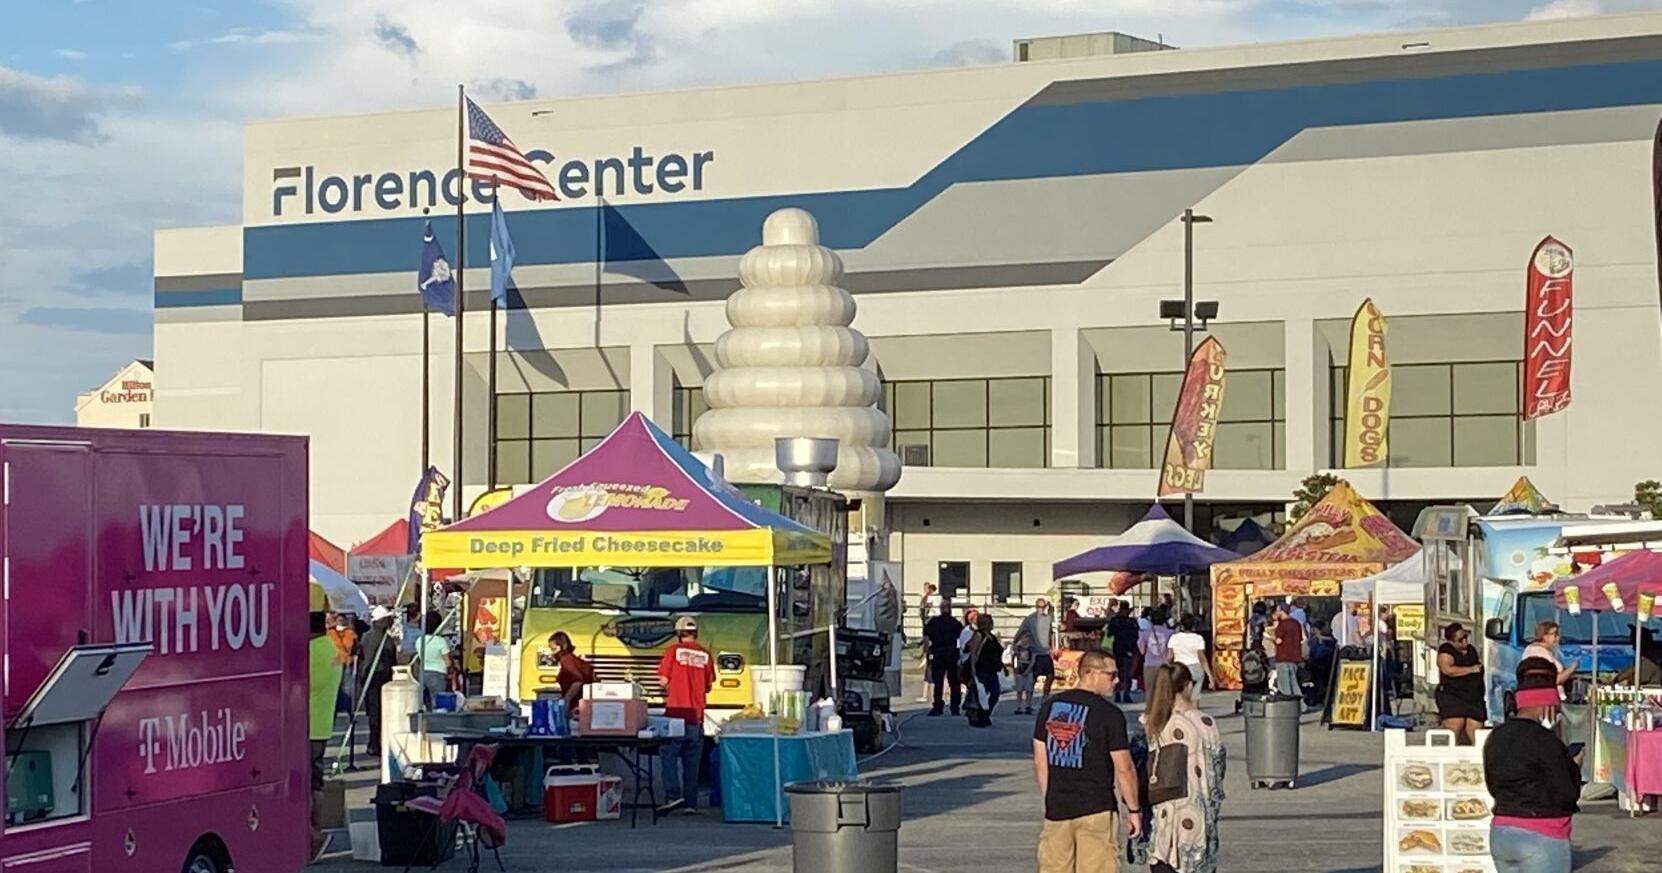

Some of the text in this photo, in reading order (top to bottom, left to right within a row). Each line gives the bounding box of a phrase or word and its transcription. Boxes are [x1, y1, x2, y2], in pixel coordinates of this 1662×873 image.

[1531, 278, 1571, 398] FUNNEL
[101, 390, 147, 404] Garden
[1359, 396, 1384, 463] DOGS
[583, 491, 690, 512] LEMONADE
[139, 505, 245, 572] WE'RE
[470, 535, 724, 557] Deep Fried Cheesecake
[111, 583, 269, 655] WITH YOU
[1343, 667, 1366, 681] FACE
[1338, 707, 1358, 721] ART
